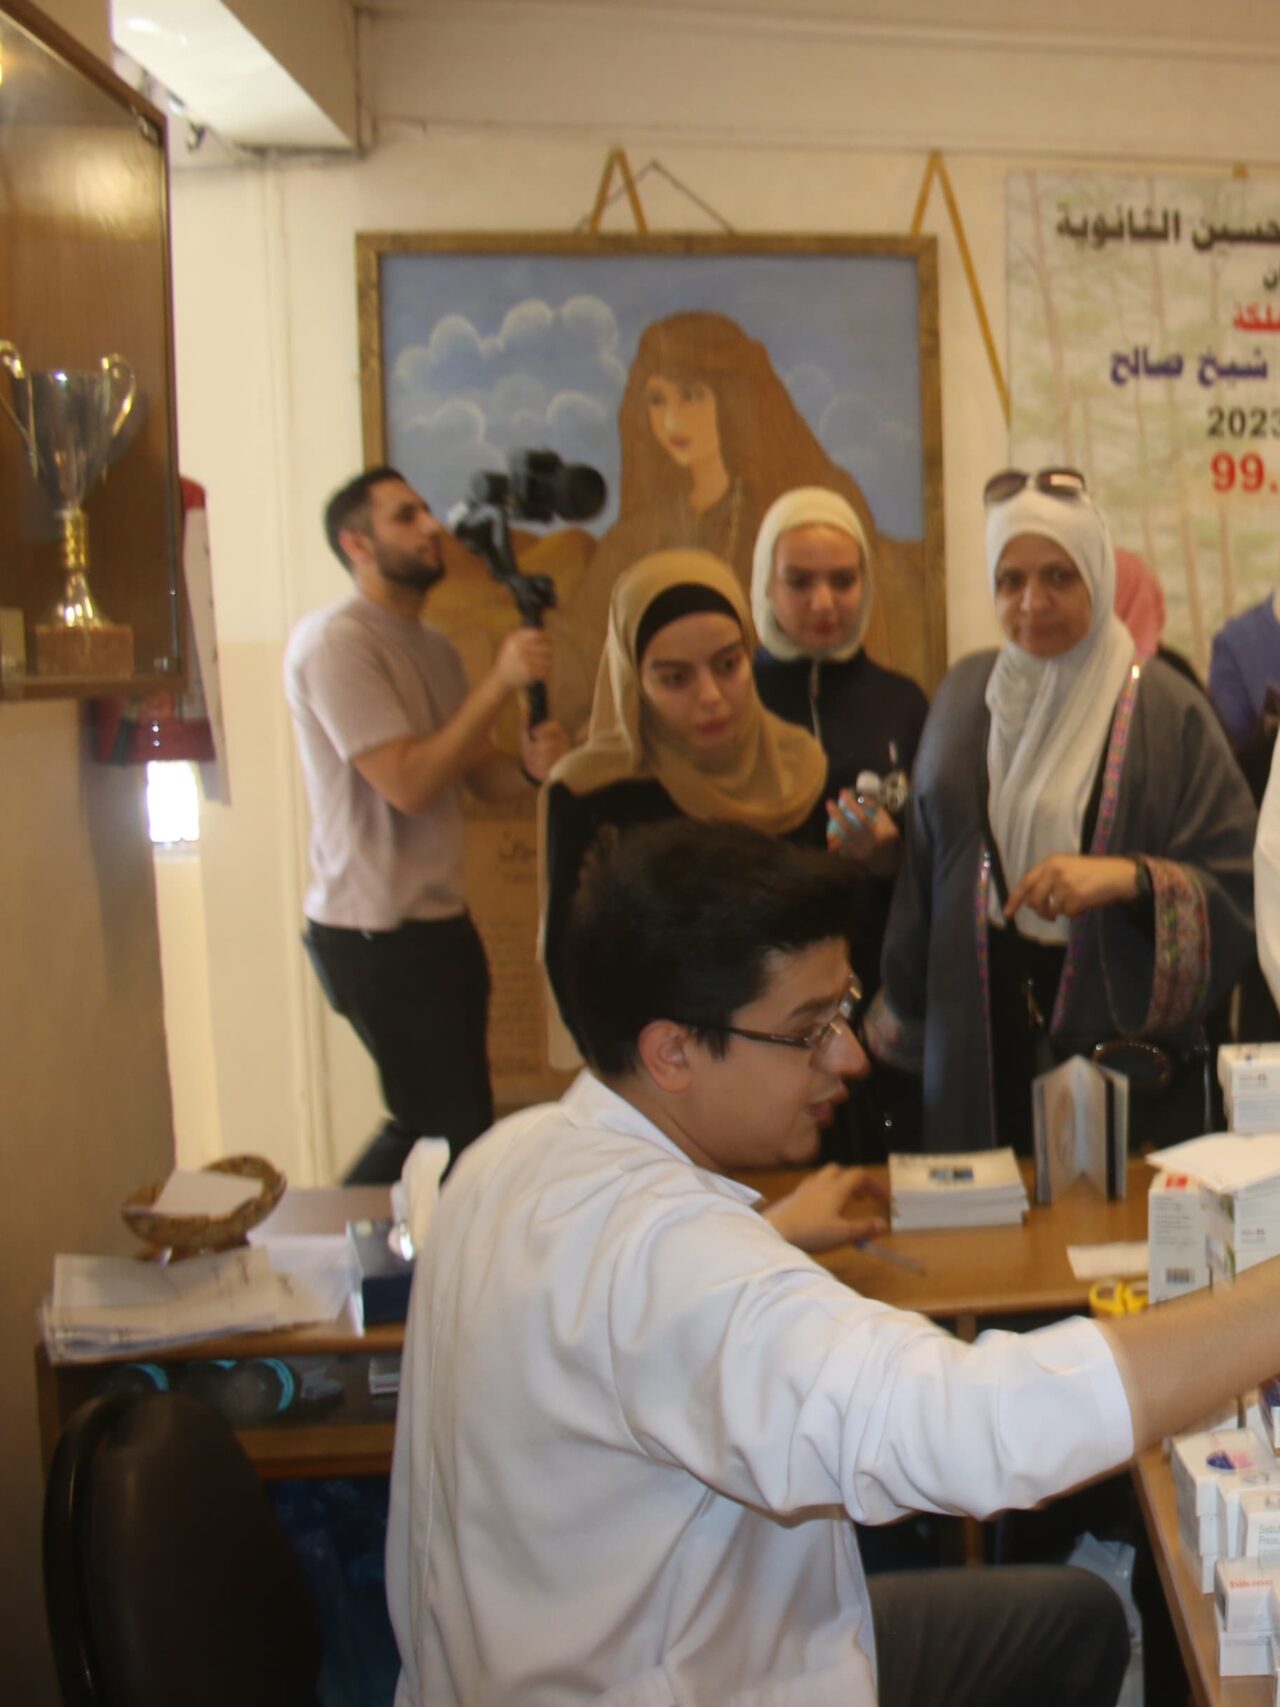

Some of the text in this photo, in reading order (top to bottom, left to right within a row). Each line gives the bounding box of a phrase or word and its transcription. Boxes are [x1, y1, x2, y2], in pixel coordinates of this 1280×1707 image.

[1056, 201, 1182, 251] الثانوية
[1110, 345, 1184, 387] صالح
[1197, 345, 1268, 388] شيخ
